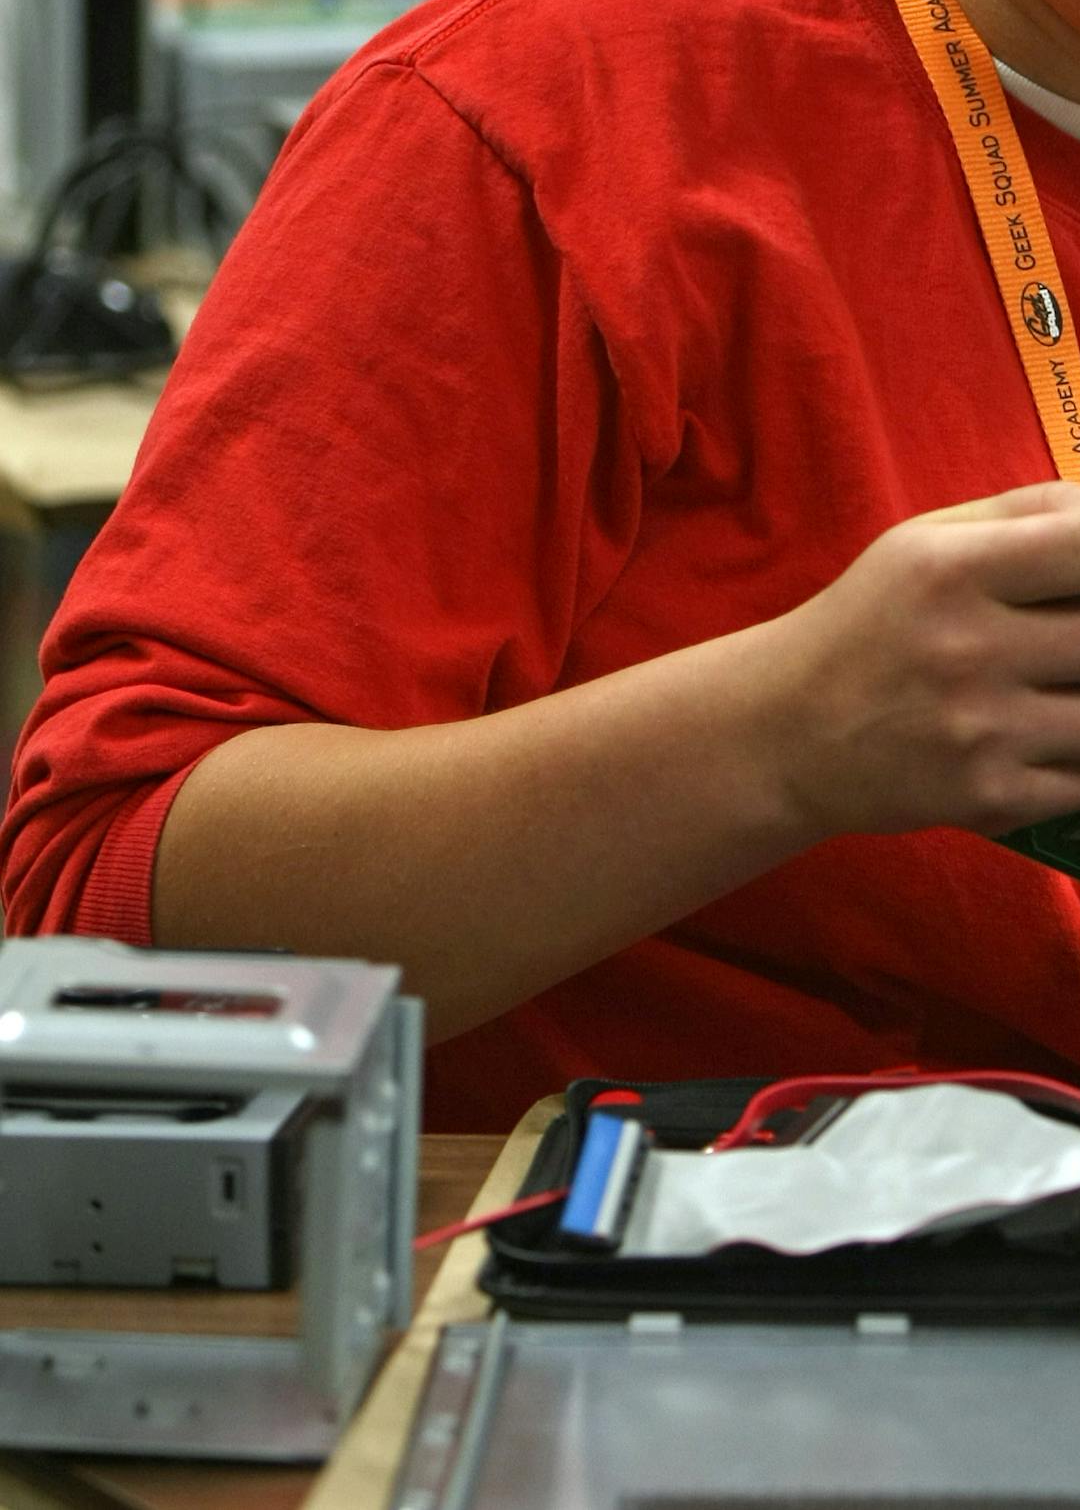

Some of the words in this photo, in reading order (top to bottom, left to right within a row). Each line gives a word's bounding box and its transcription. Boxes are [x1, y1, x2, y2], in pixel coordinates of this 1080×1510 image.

[946, 40, 991, 127] SUMMER
[981, 135, 1016, 206] SQUAD
[1006, 213, 1036, 271] GEEK
